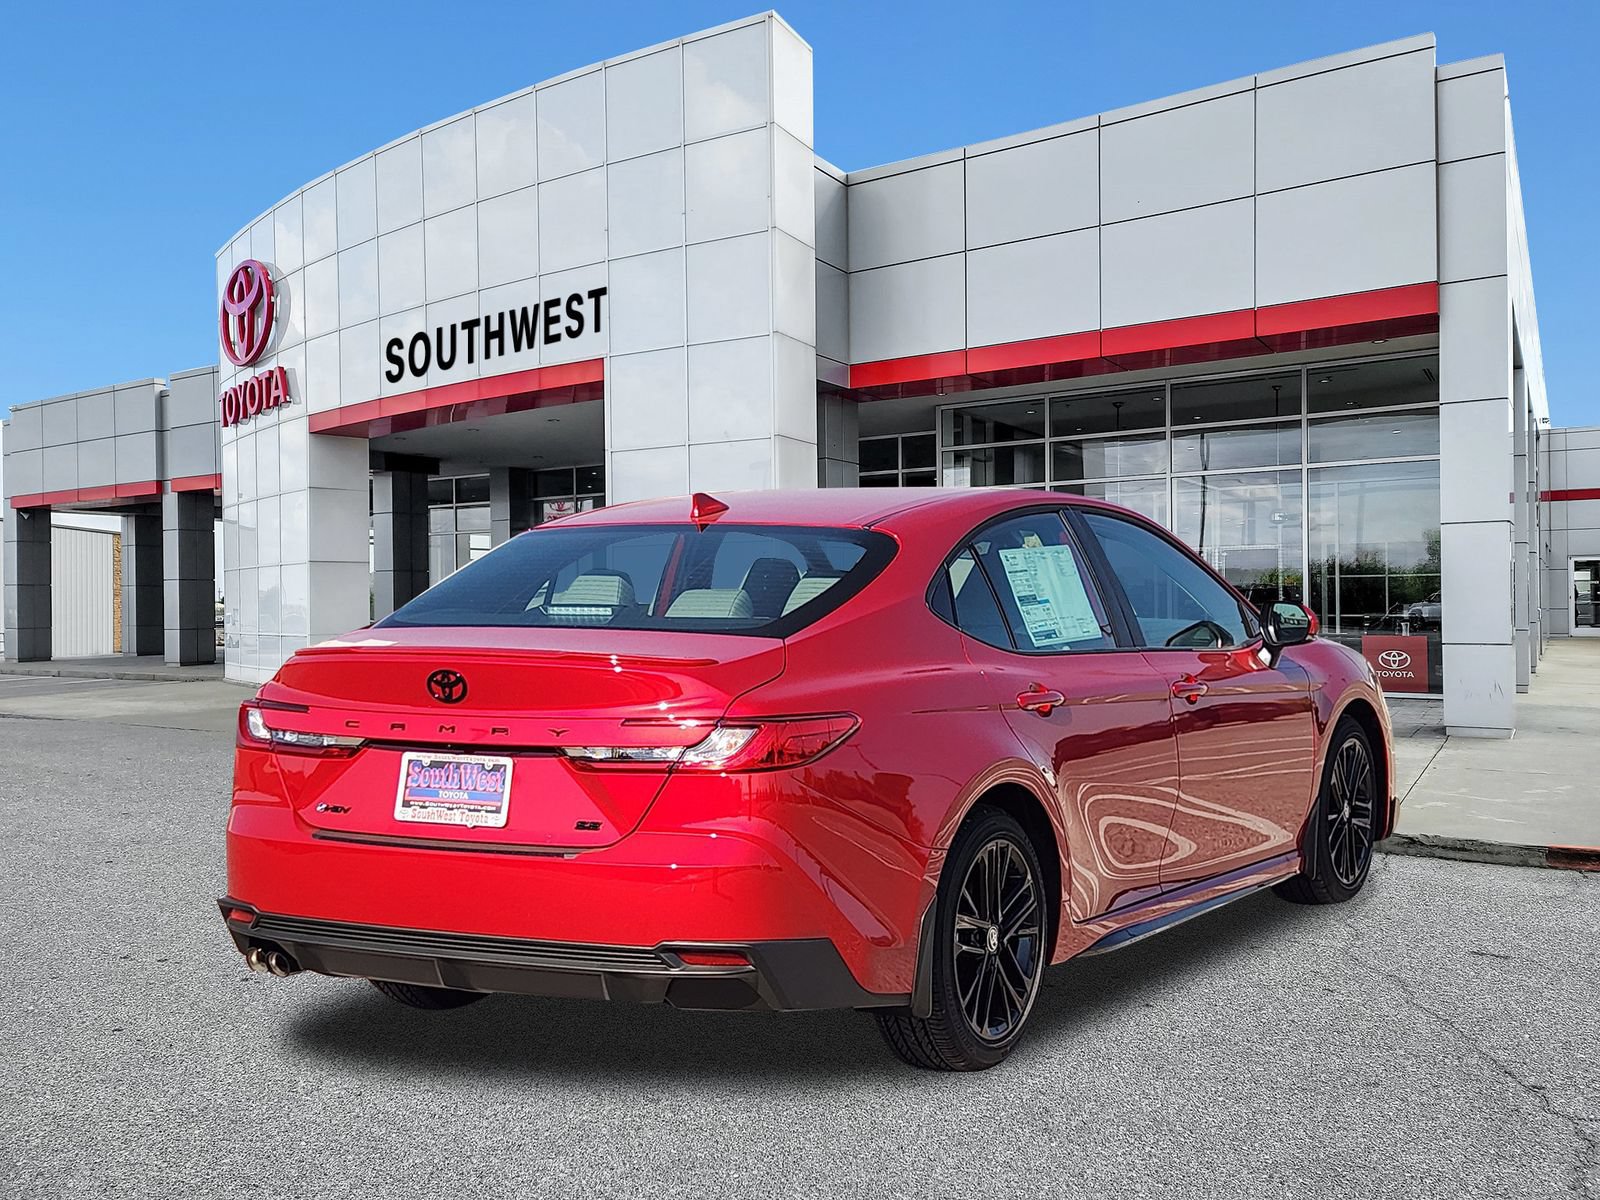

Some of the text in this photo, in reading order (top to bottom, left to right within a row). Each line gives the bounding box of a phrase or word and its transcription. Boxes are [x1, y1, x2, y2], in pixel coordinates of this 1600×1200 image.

[385, 286, 608, 384] SOUTHWEST
[219, 365, 290, 428] TOYOTA
[1376, 670, 1415, 678] TOYOTA
[345, 720, 569, 737] CAMRY
[438, 790, 469, 800] TOYOTA
[459, 811, 489, 825] Toyota
